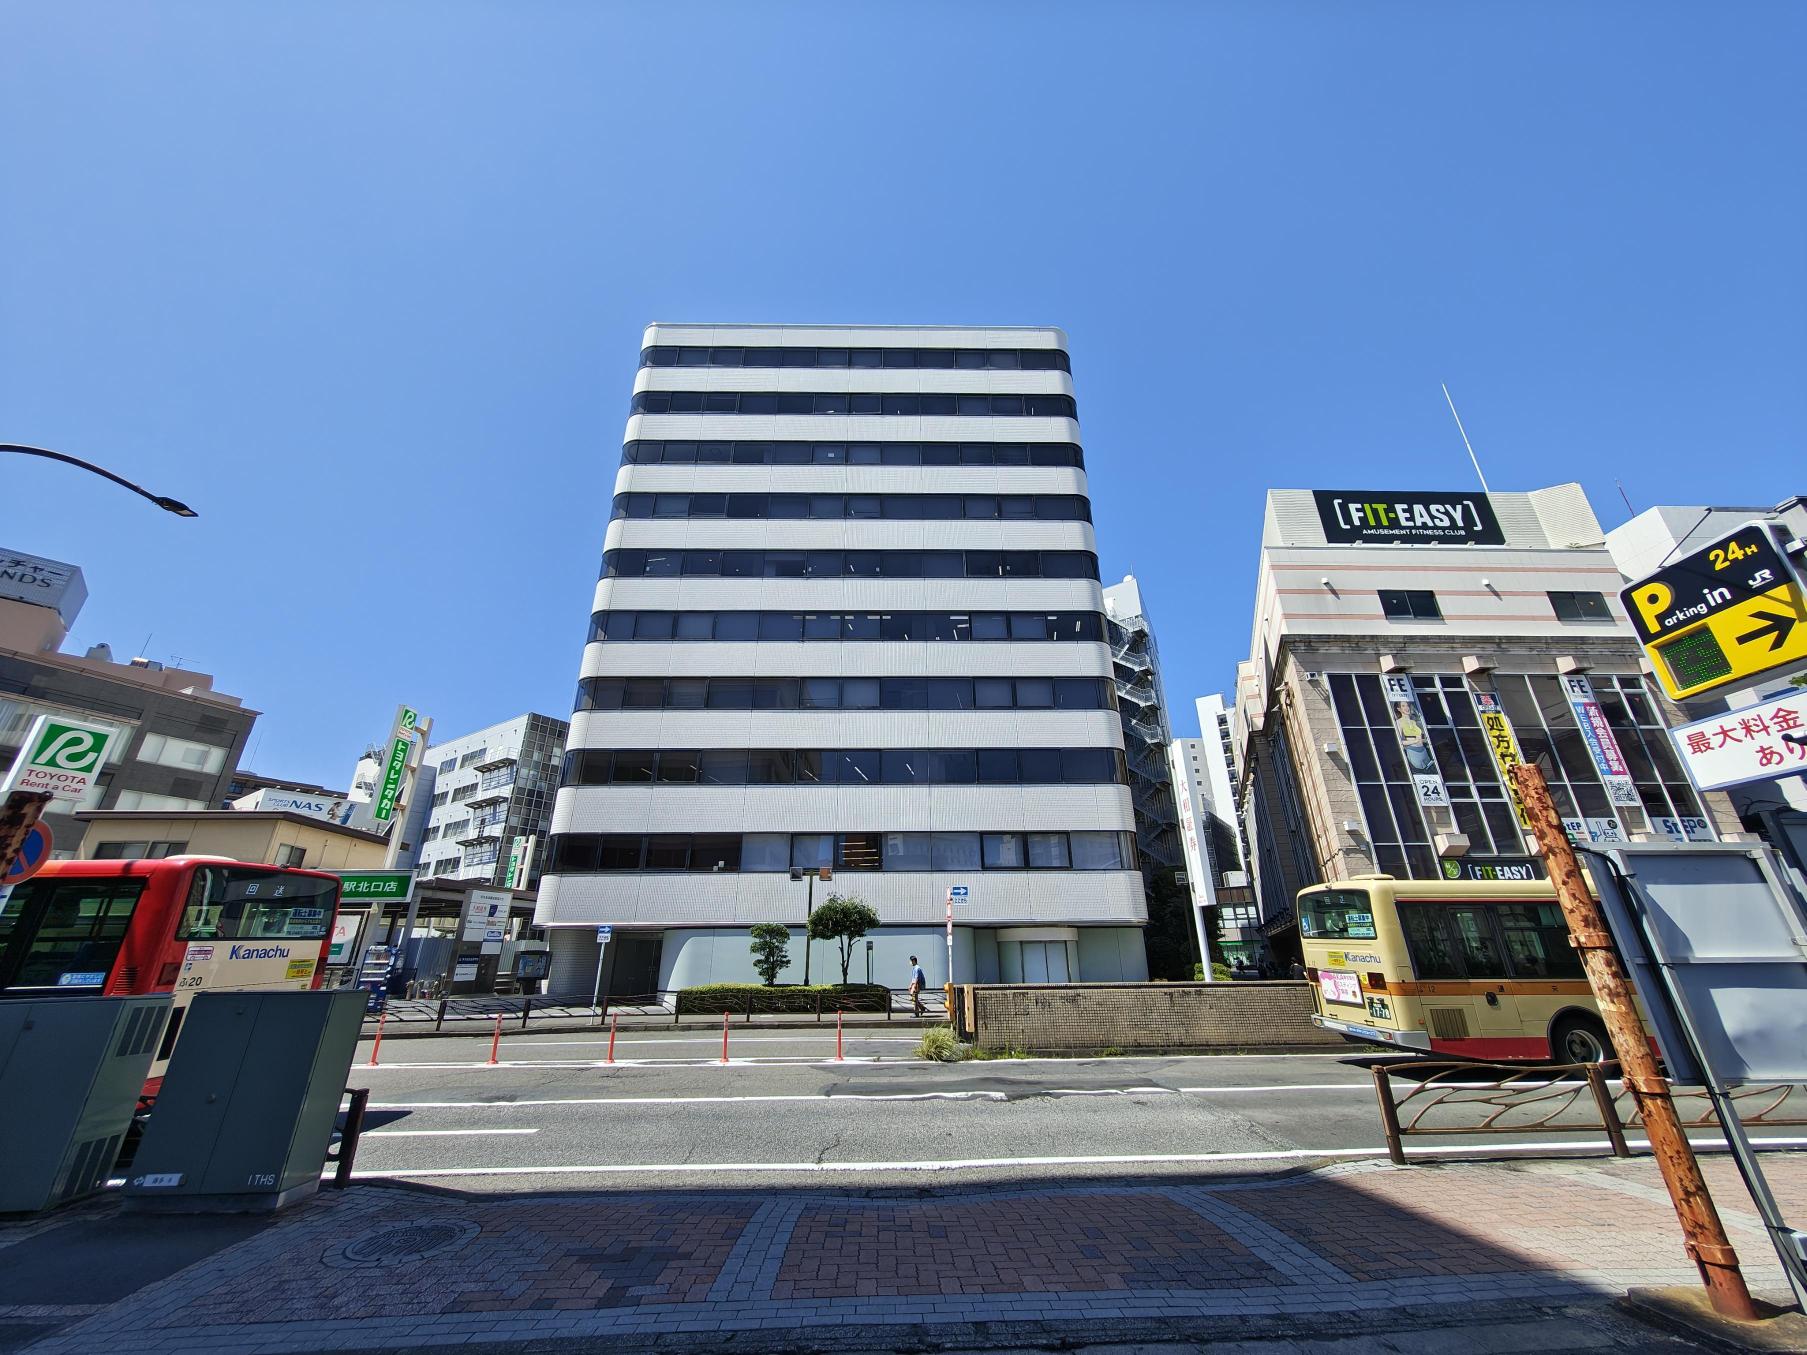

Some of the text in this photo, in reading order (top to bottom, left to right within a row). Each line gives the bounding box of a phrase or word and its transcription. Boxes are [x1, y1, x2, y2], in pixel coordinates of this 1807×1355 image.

[0, 559, 66, 577] チャー
[1747, 568, 1774, 588] JR
[1702, 586, 1732, 607] in
[1686, 707, 1805, 755] 最大料金
[27, 769, 87, 785] TOYOTA
[380, 741, 407, 819] トヨタレンタカー
[20, 778, 50, 789] Rent
[62, 784, 83, 794] Car
[1421, 785, 1440, 797] 24
[289, 799, 325, 812] NAS
[246, 883, 285, 897] 回送
[342, 881, 399, 892] 駅北口店
[229, 944, 290, 961] Kanachu
[1344, 951, 1381, 964] Kanachu
